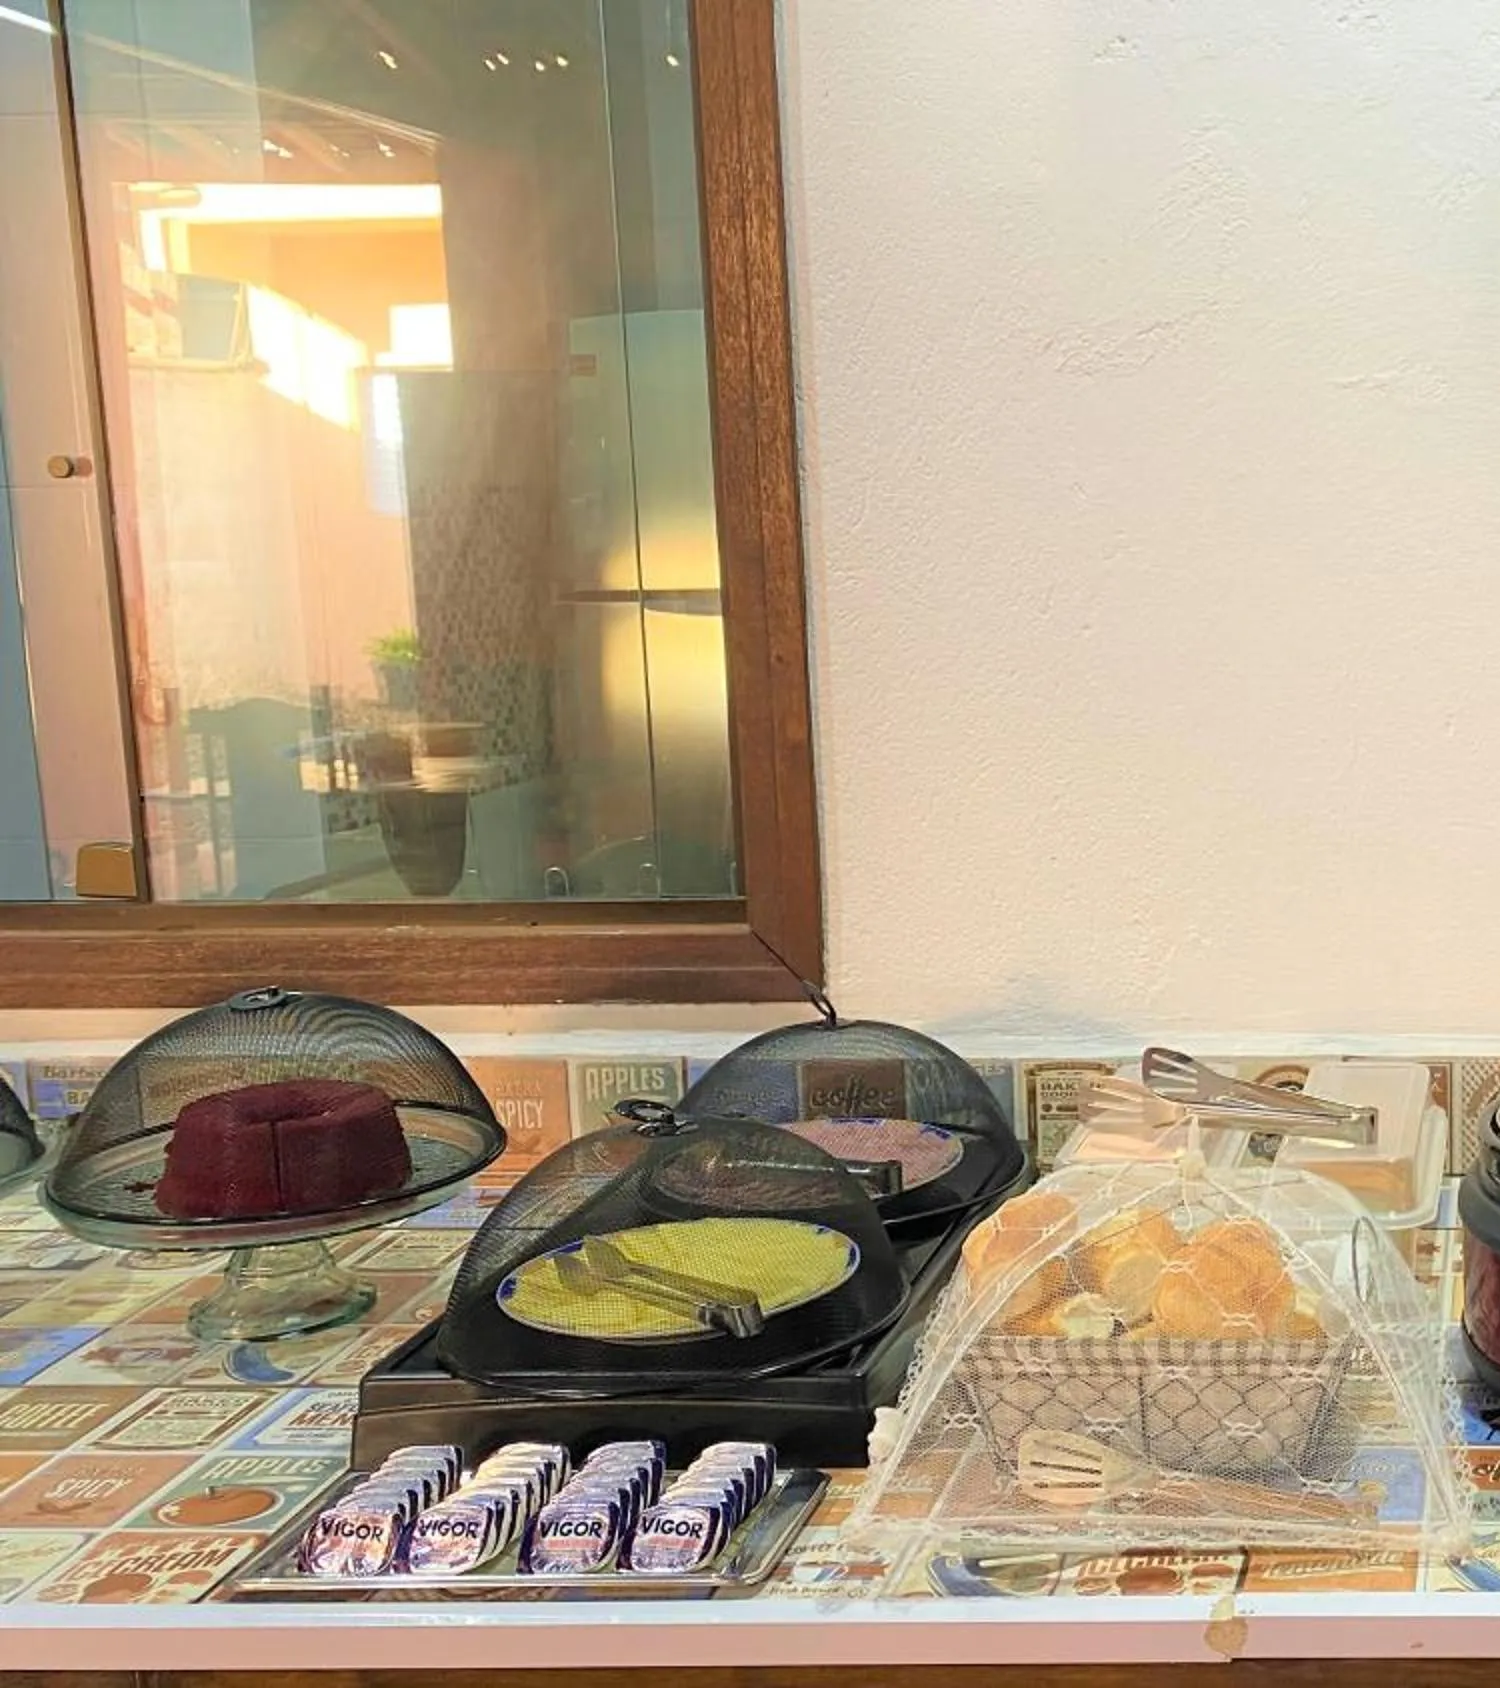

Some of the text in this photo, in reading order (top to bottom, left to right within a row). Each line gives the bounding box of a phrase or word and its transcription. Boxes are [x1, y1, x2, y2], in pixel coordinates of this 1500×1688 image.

[585, 1066, 666, 1101] APPLES
[495, 1099, 544, 1130] SPICY
[321, 1517, 384, 1543] VIGOR
[419, 1519, 480, 1539] VIGOR
[540, 1520, 603, 1539] VIGOR
[641, 1516, 704, 1540] VIGOR
